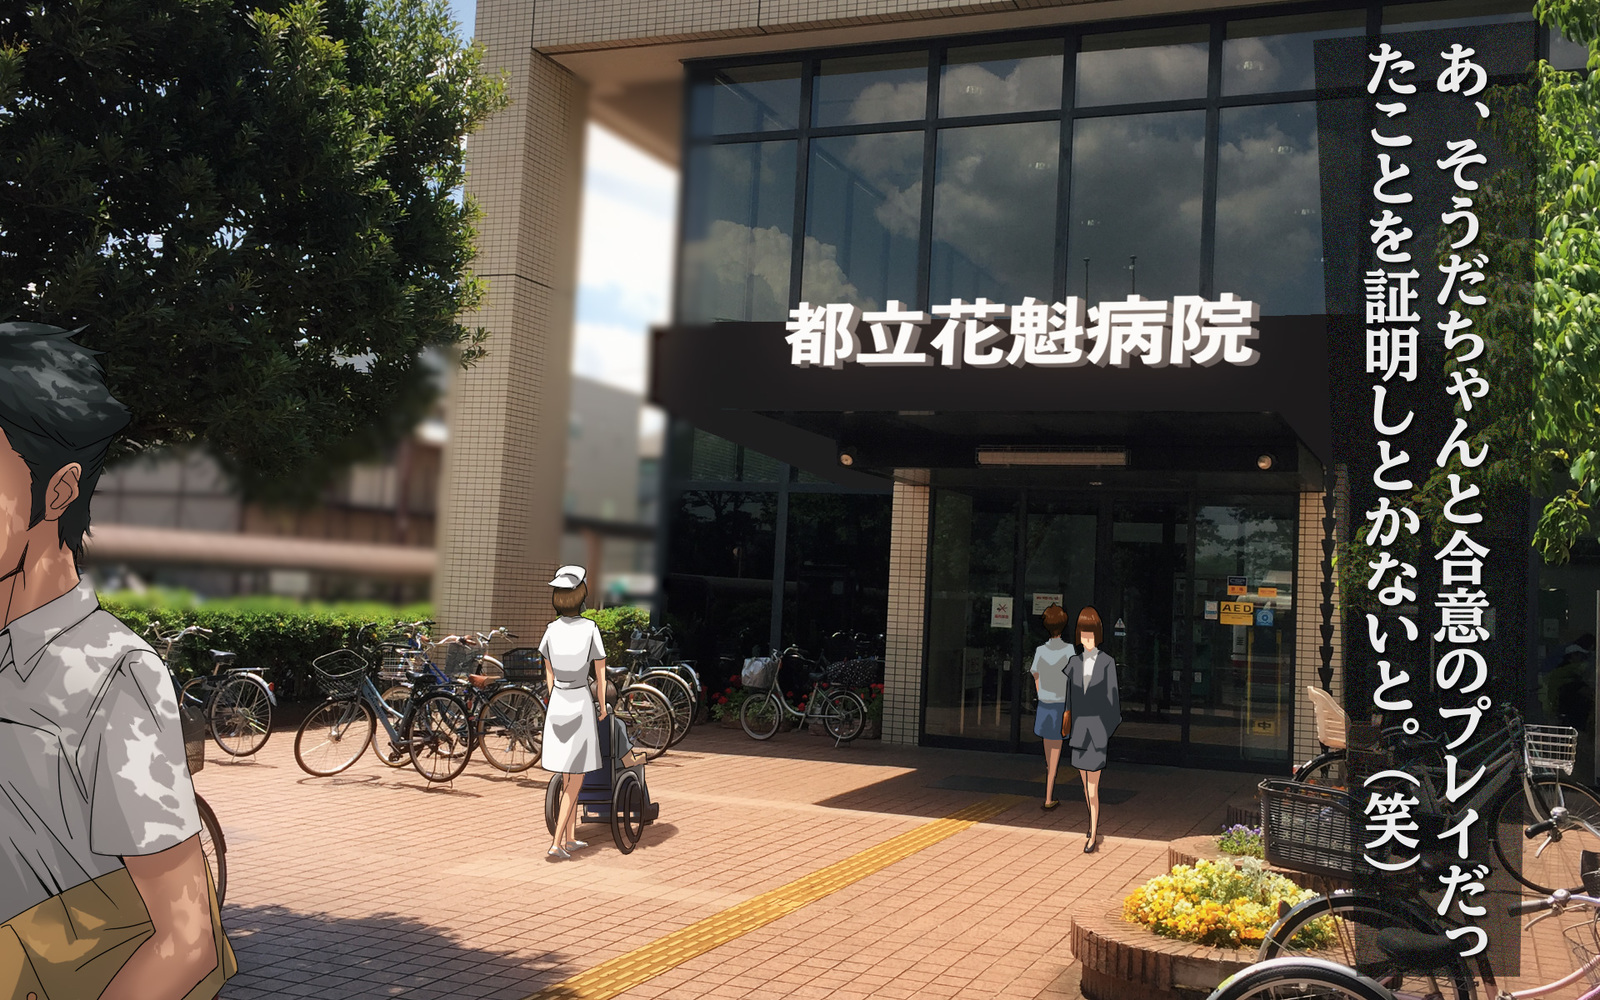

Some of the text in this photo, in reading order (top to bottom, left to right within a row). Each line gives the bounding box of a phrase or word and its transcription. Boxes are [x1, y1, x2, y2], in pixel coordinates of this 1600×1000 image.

[785, 292, 1254, 367] 都立花魁病院
[1222, 604, 1252, 613] AED
